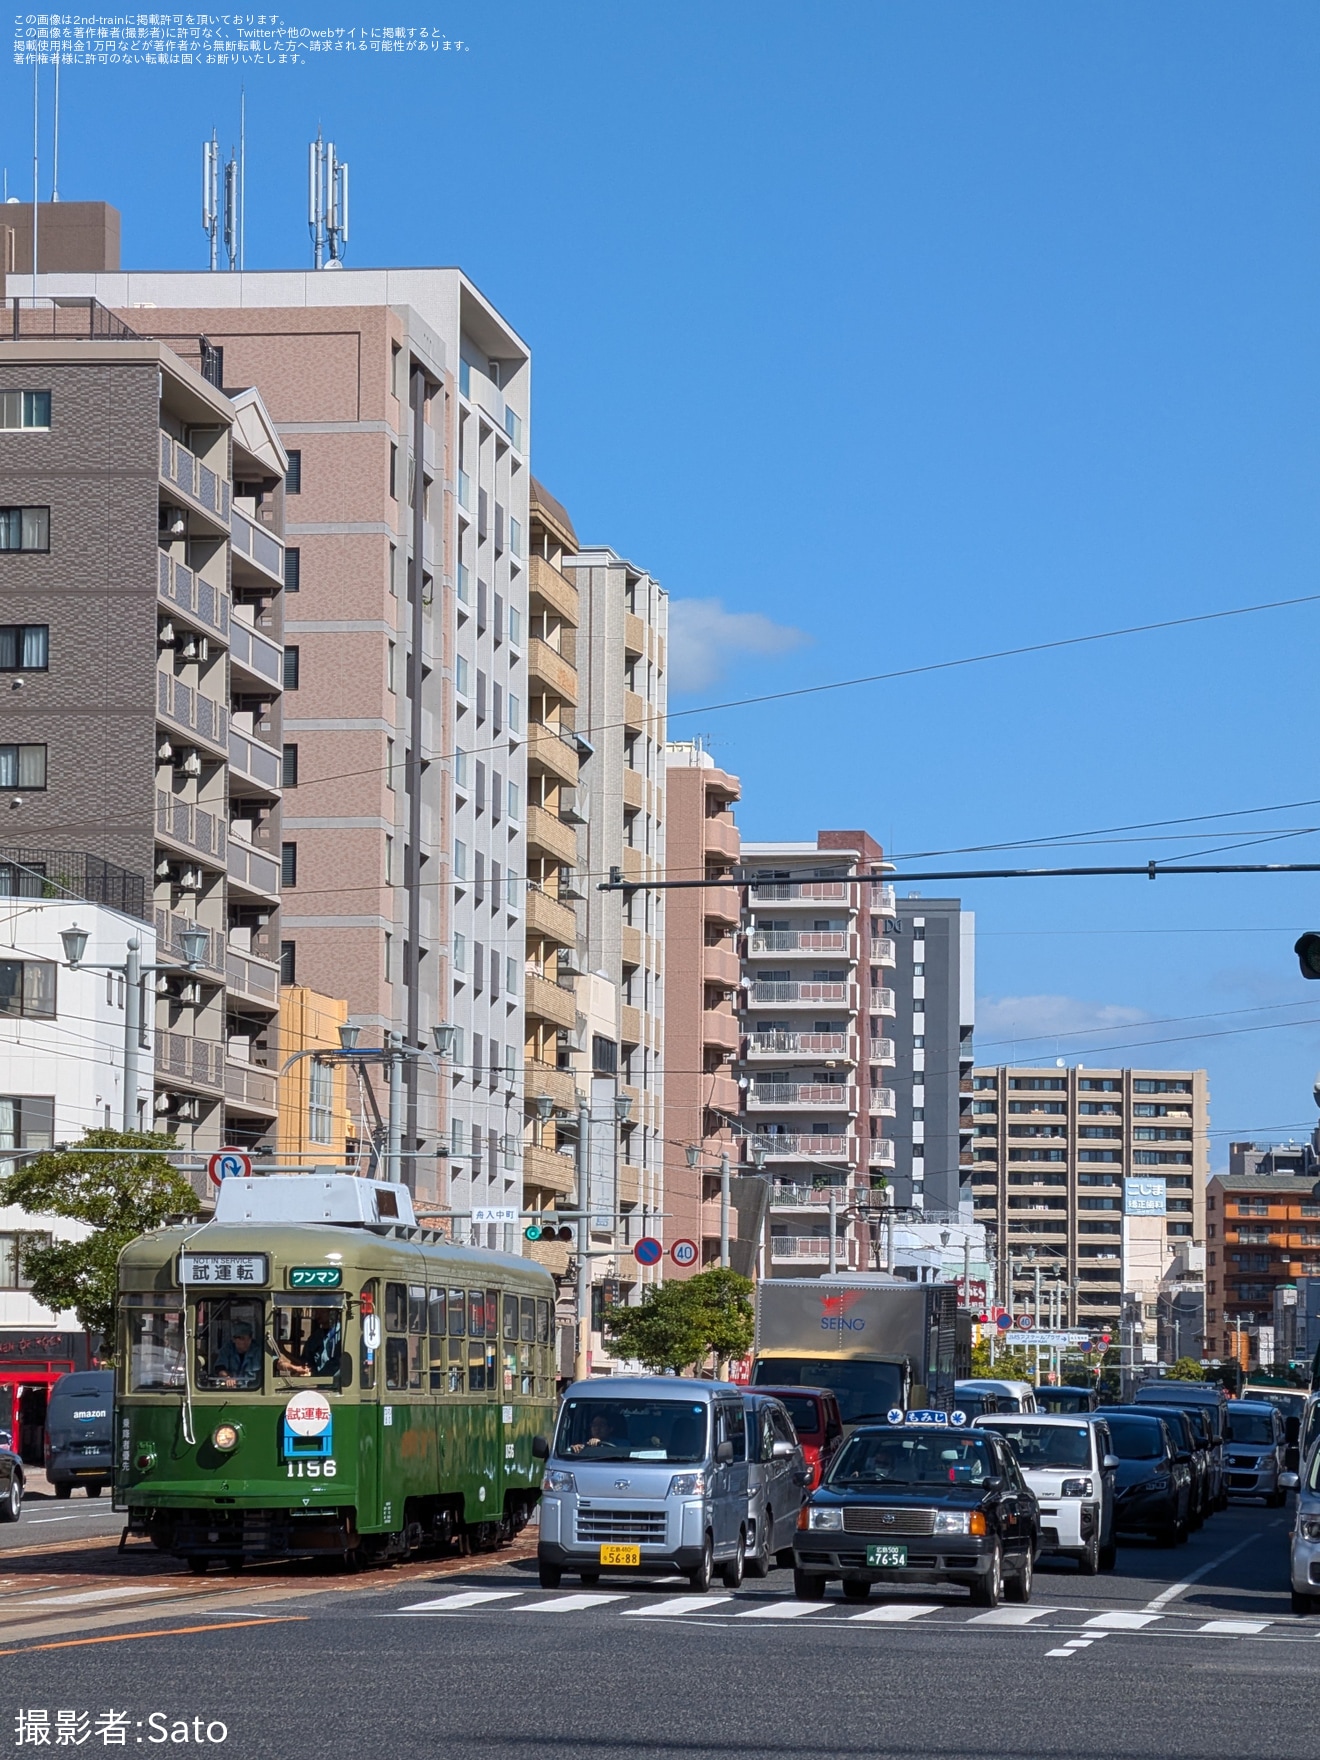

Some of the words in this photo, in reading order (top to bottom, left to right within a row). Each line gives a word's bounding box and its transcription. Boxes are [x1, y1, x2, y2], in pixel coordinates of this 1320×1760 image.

[1128, 1184, 1163, 1196] こじま
[475, 1209, 515, 1220] 舟入中町
[676, 1246, 693, 1260] 40
[192, 1264, 254, 1281] 試運転
[293, 1271, 340, 1284] ワンマン
[820, 1316, 866, 1331] SEINO
[1020, 1318, 1030, 1327] 40
[73, 1410, 106, 1419] amazon
[287, 1407, 330, 1421] 試運転
[907, 1413, 945, 1423] もみじ
[287, 1459, 337, 1478] 1156
[608, 1553, 637, 1564] 56-88
[875, 1553, 905, 1566] 76-54
